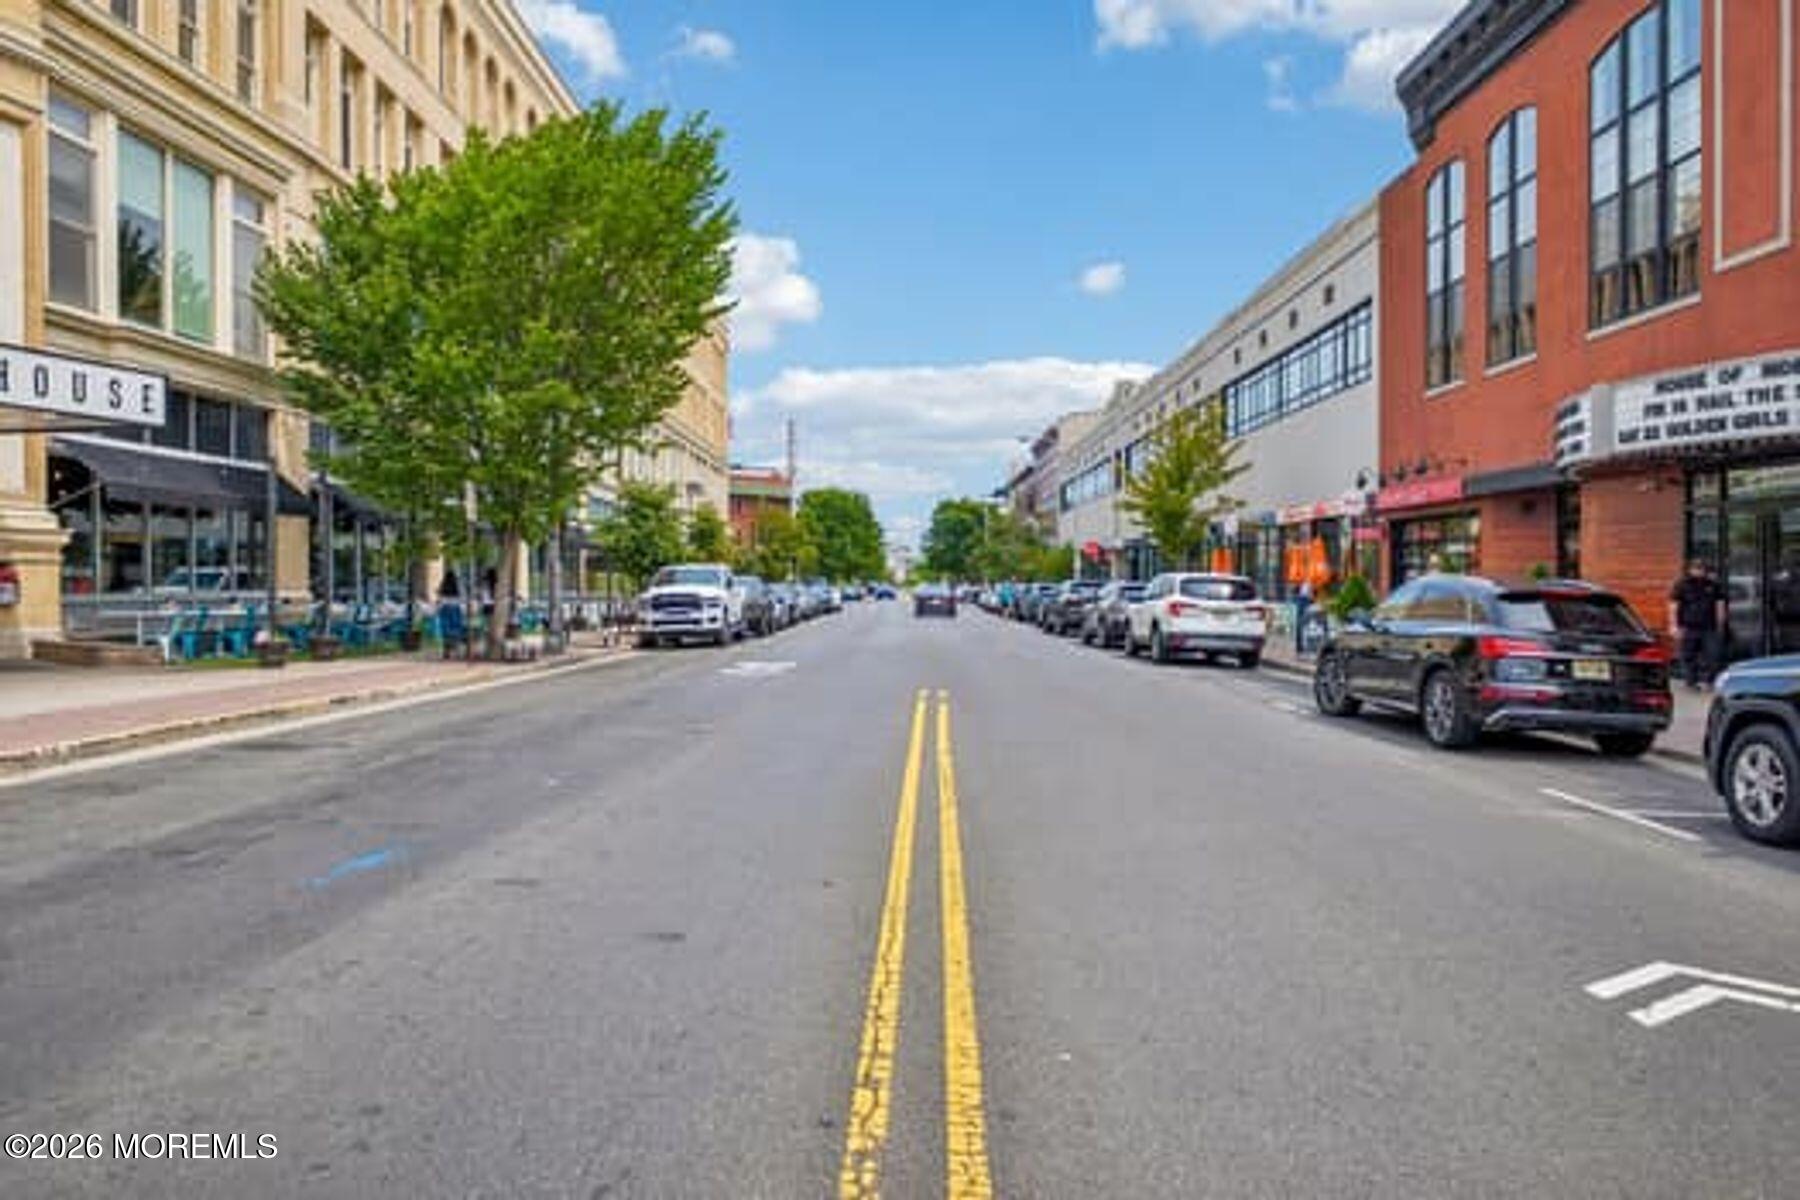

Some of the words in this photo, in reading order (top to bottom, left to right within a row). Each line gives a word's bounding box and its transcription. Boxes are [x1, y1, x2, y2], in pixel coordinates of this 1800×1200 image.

[1718, 366, 1742, 385] OF
[1747, 385, 1784, 406] THE
[1732, 411, 1787, 430] GIRLS
